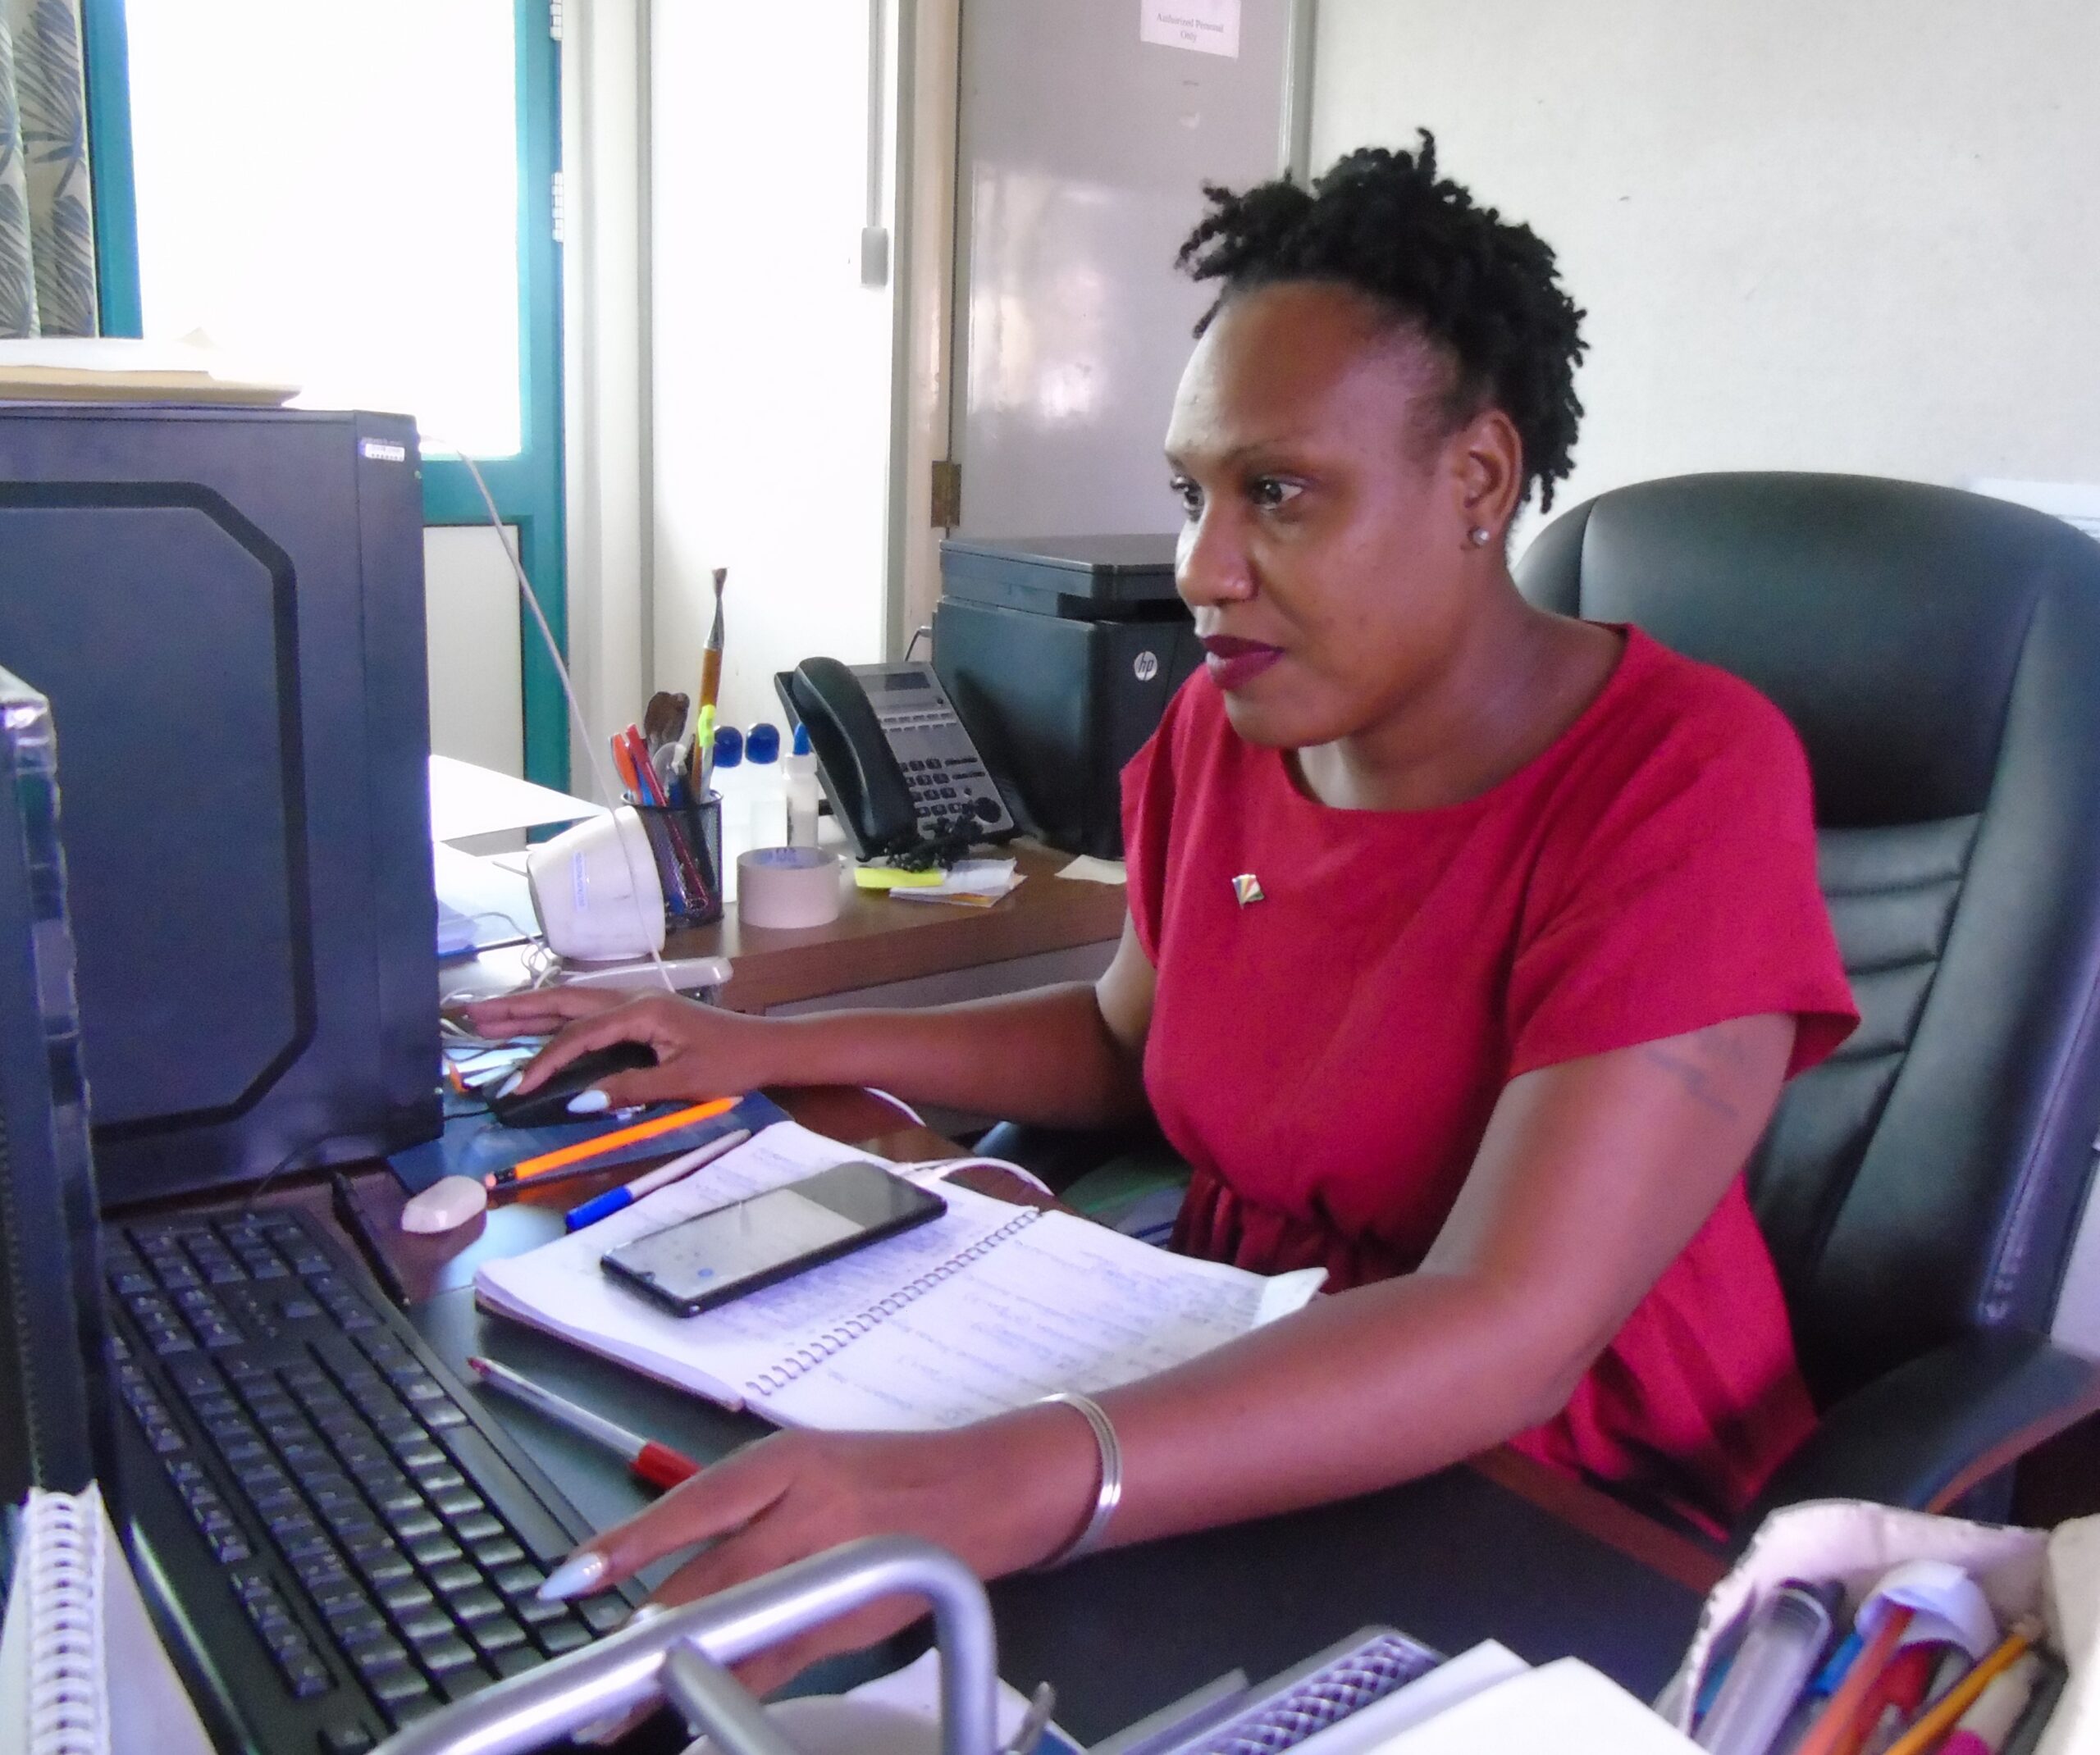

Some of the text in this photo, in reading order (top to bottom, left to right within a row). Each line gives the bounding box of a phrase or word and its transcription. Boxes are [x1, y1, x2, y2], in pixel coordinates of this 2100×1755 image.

[1157, 13, 1194, 27] Authorized
[1180, 30, 1197, 43] Only
[1137, 651, 1155, 681] hp
